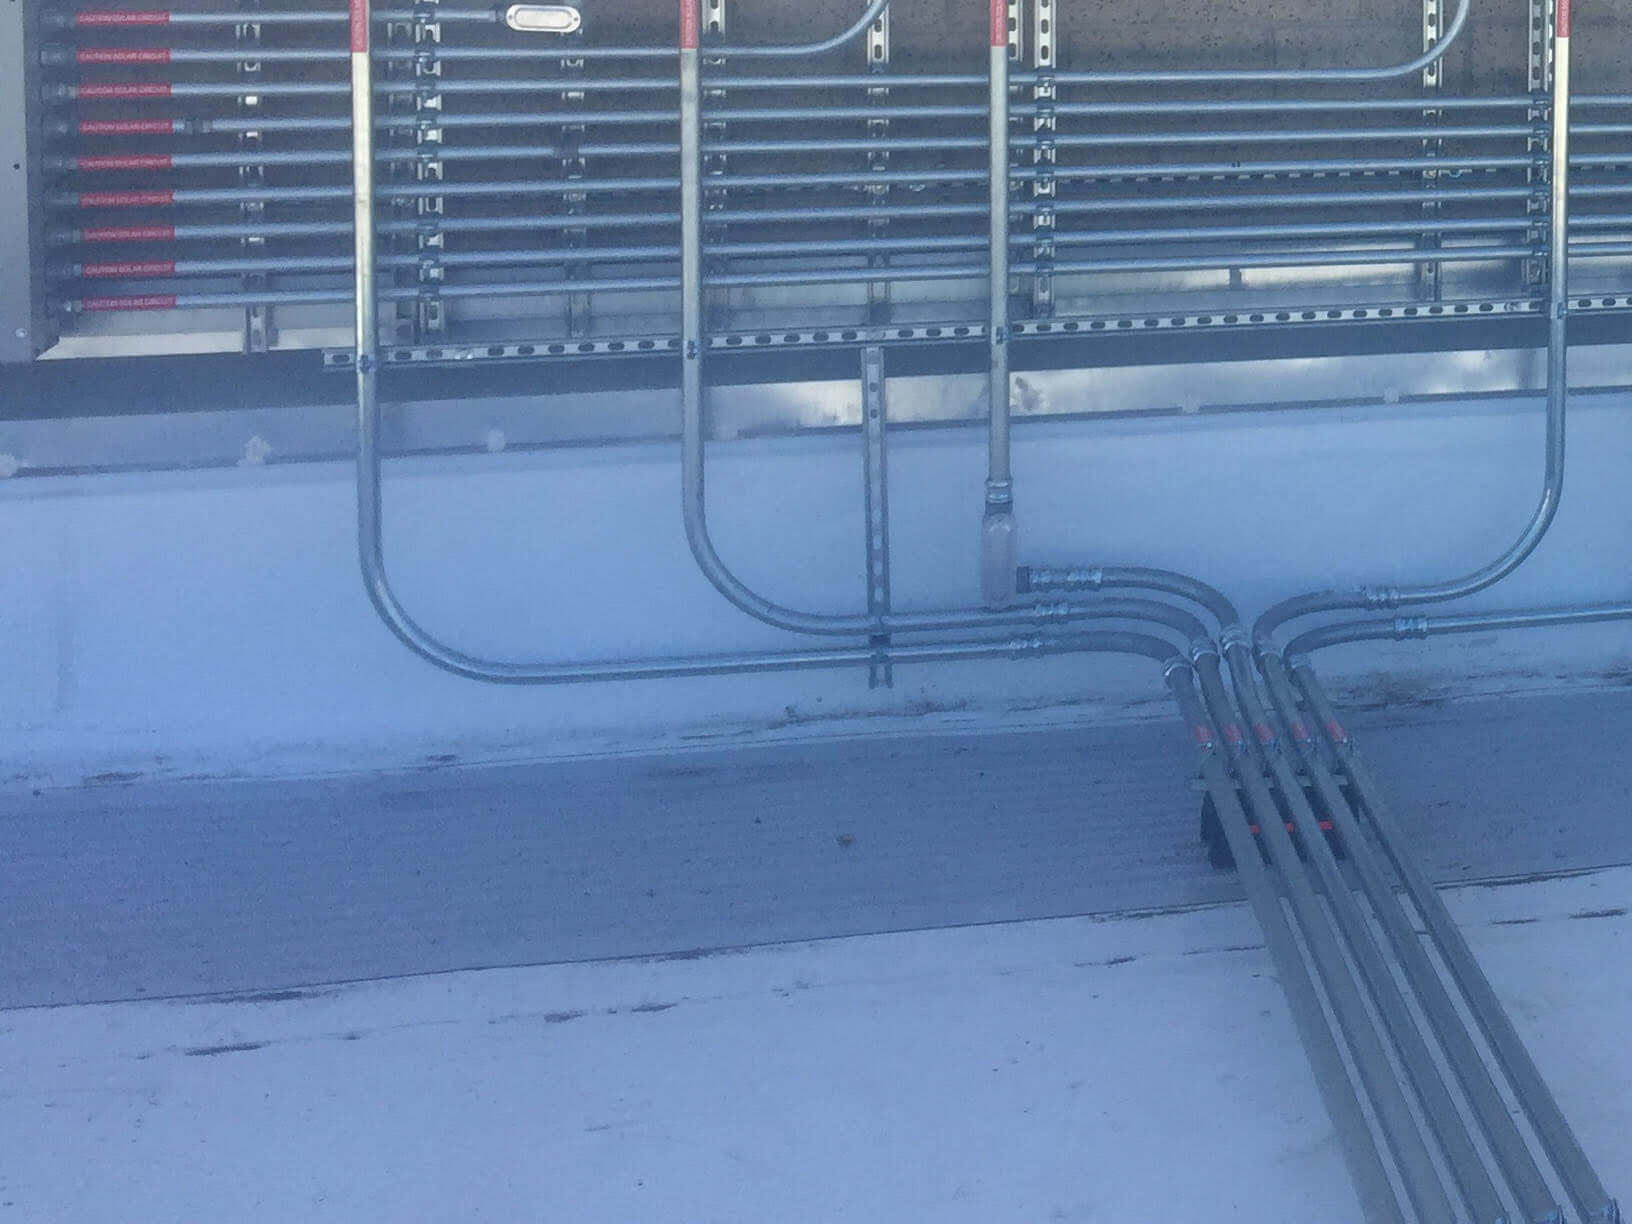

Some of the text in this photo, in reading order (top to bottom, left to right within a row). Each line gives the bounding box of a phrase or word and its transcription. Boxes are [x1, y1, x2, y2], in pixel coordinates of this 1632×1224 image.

[86, 263, 171, 274] CAUTION SOLAR CIRCUIT
